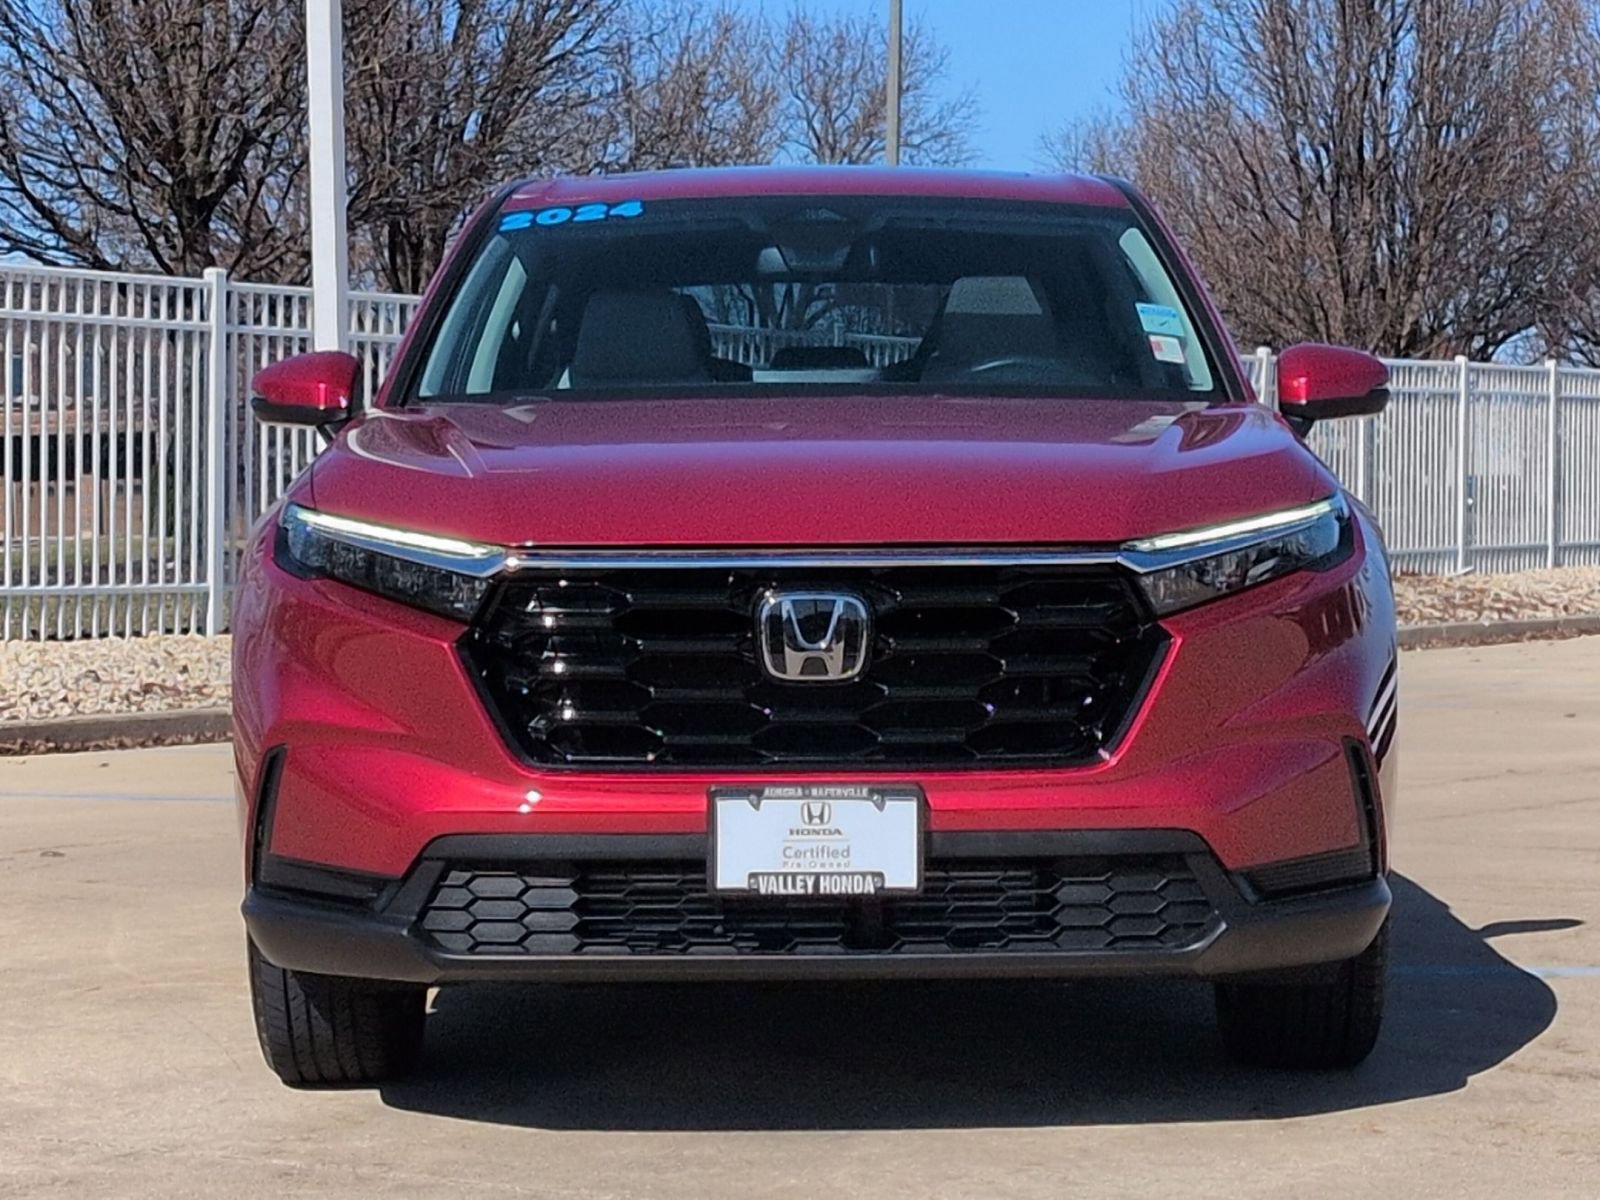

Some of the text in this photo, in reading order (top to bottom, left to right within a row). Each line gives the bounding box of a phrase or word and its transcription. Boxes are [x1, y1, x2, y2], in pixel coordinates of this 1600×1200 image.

[498, 199, 643, 231] 2024
[789, 828, 843, 836] HONDA
[783, 846, 851, 859] Certified
[758, 875, 875, 894] VALLEY HONDA
